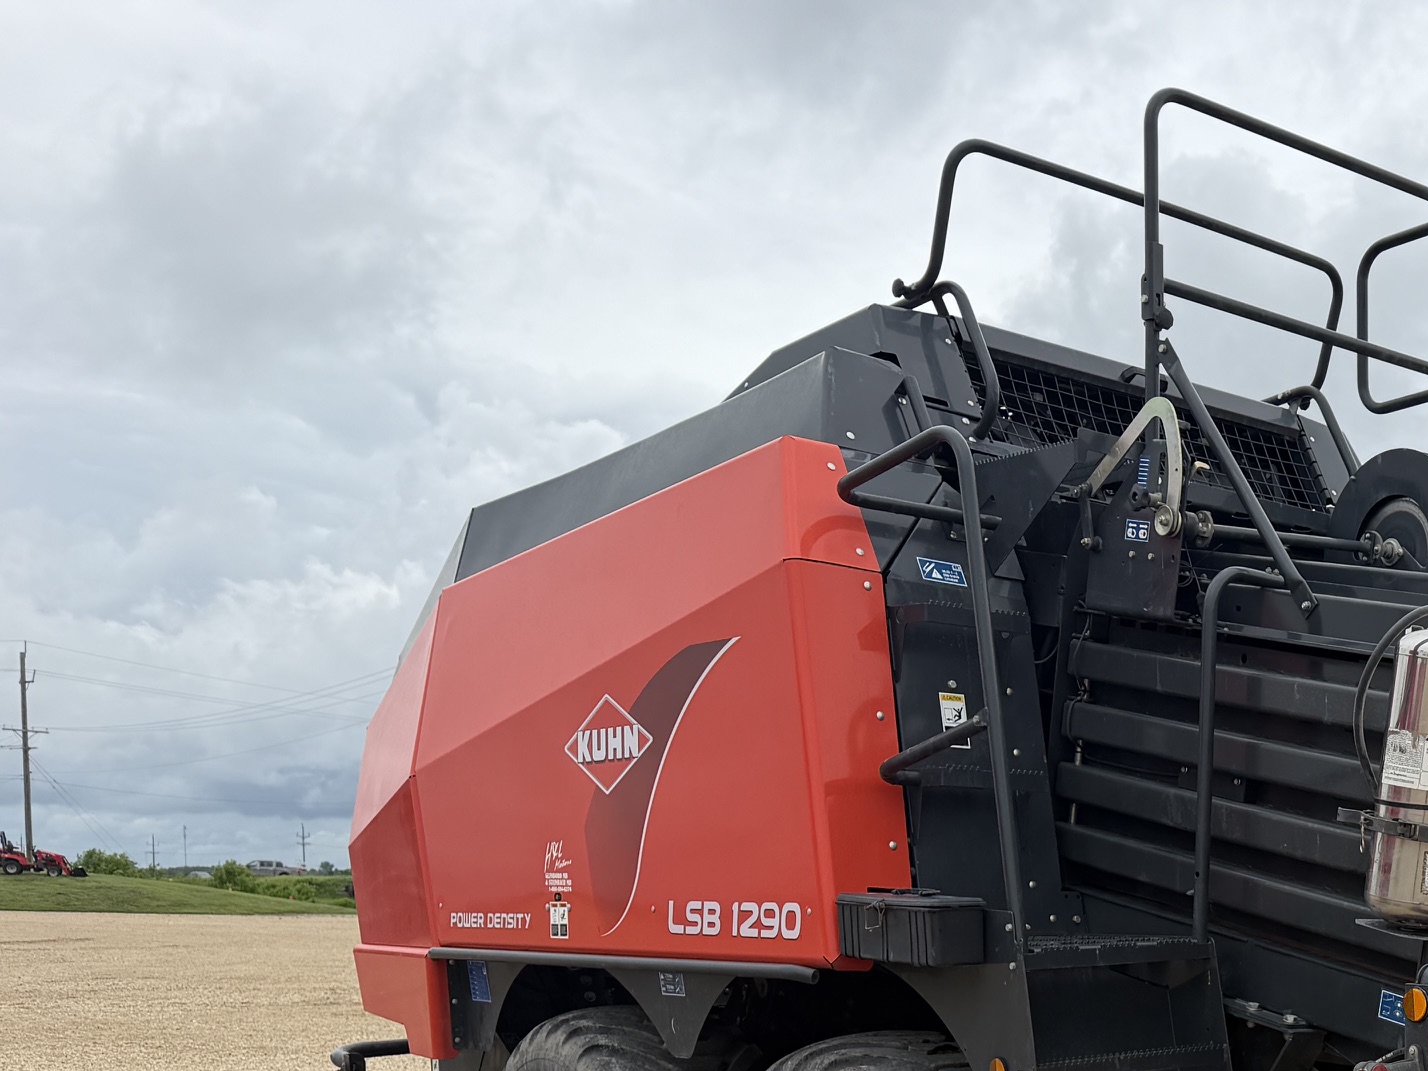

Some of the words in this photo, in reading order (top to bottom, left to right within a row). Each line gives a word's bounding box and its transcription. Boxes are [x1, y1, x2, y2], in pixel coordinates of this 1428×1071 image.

[577, 724, 639, 763] KUHN
[450, 912, 484, 928] POWER
[487, 913, 531, 929] DENSITY
[668, 900, 721, 936] LSB
[732, 901, 801, 940] 1290
